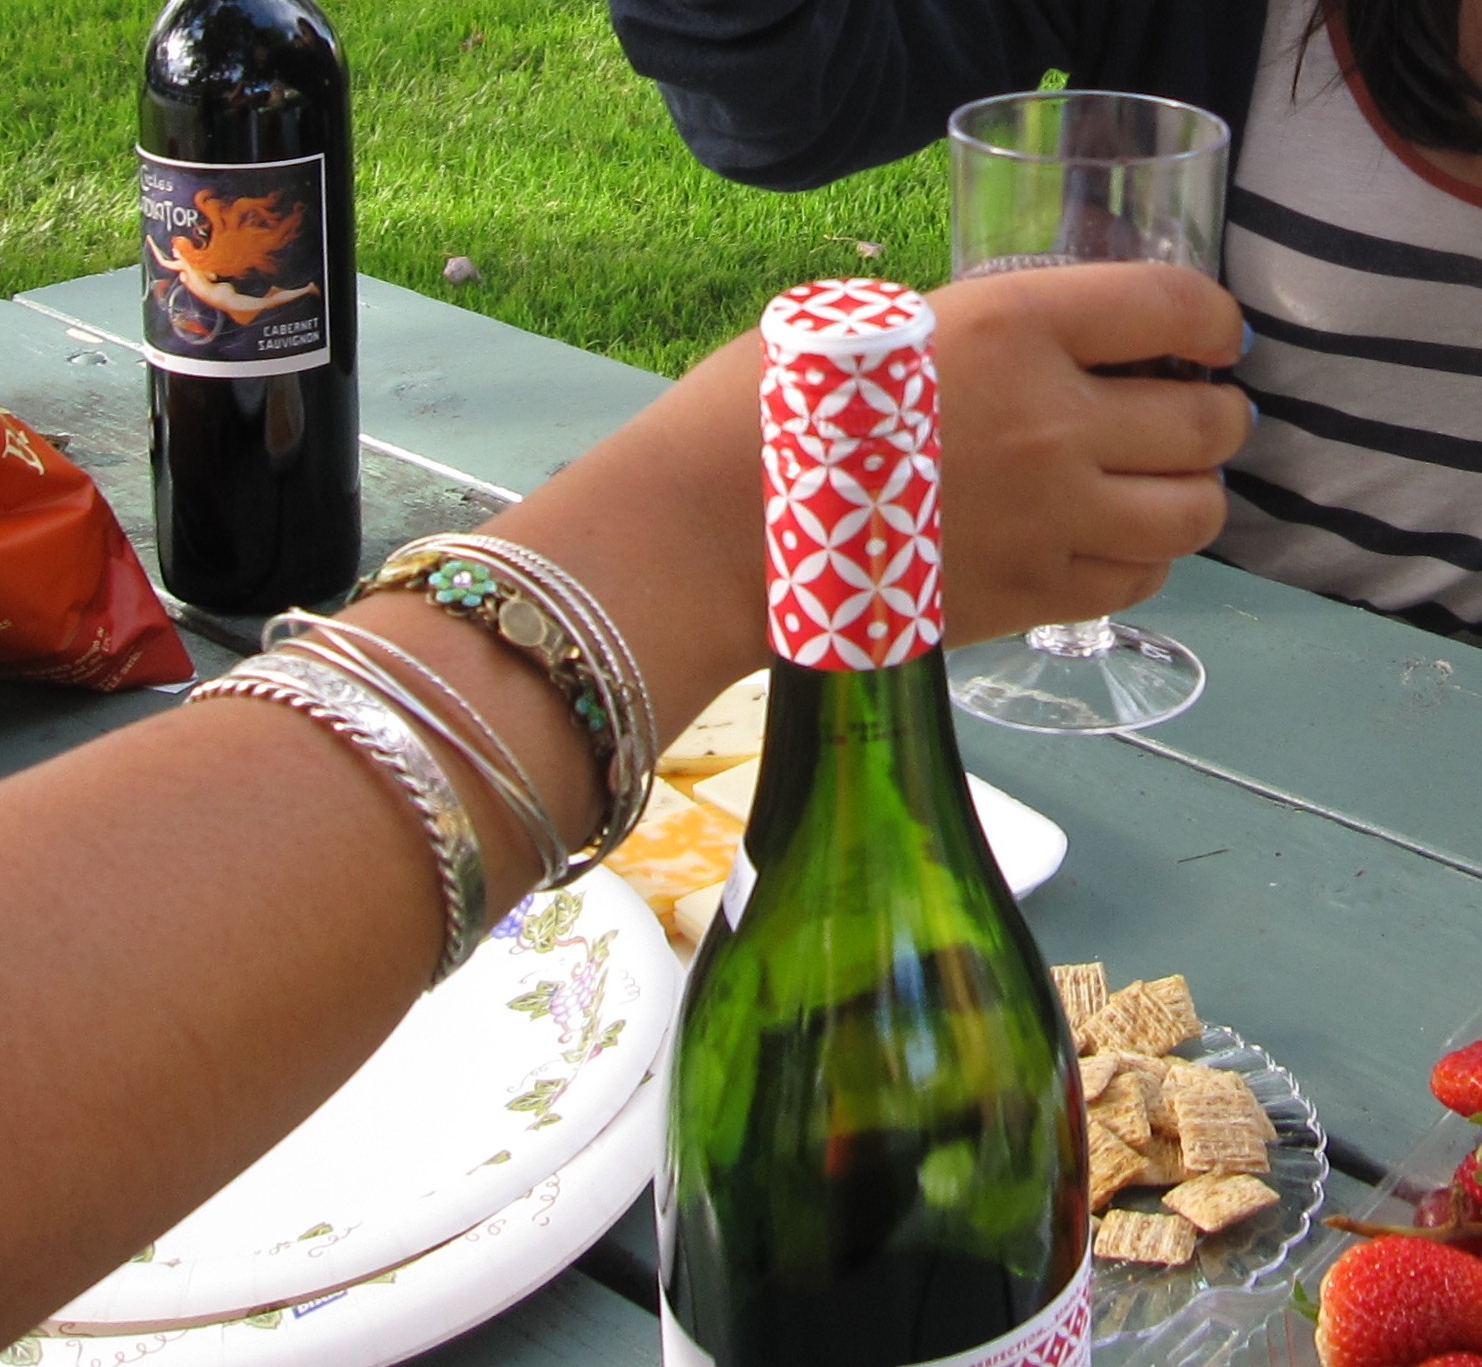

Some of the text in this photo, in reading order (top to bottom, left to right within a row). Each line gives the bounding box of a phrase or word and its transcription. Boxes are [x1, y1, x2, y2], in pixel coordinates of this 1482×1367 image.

[140, 195, 198, 232] DIATOR
[263, 317, 319, 337] CABERNET
[258, 331, 320, 351] SAUVIGNON
